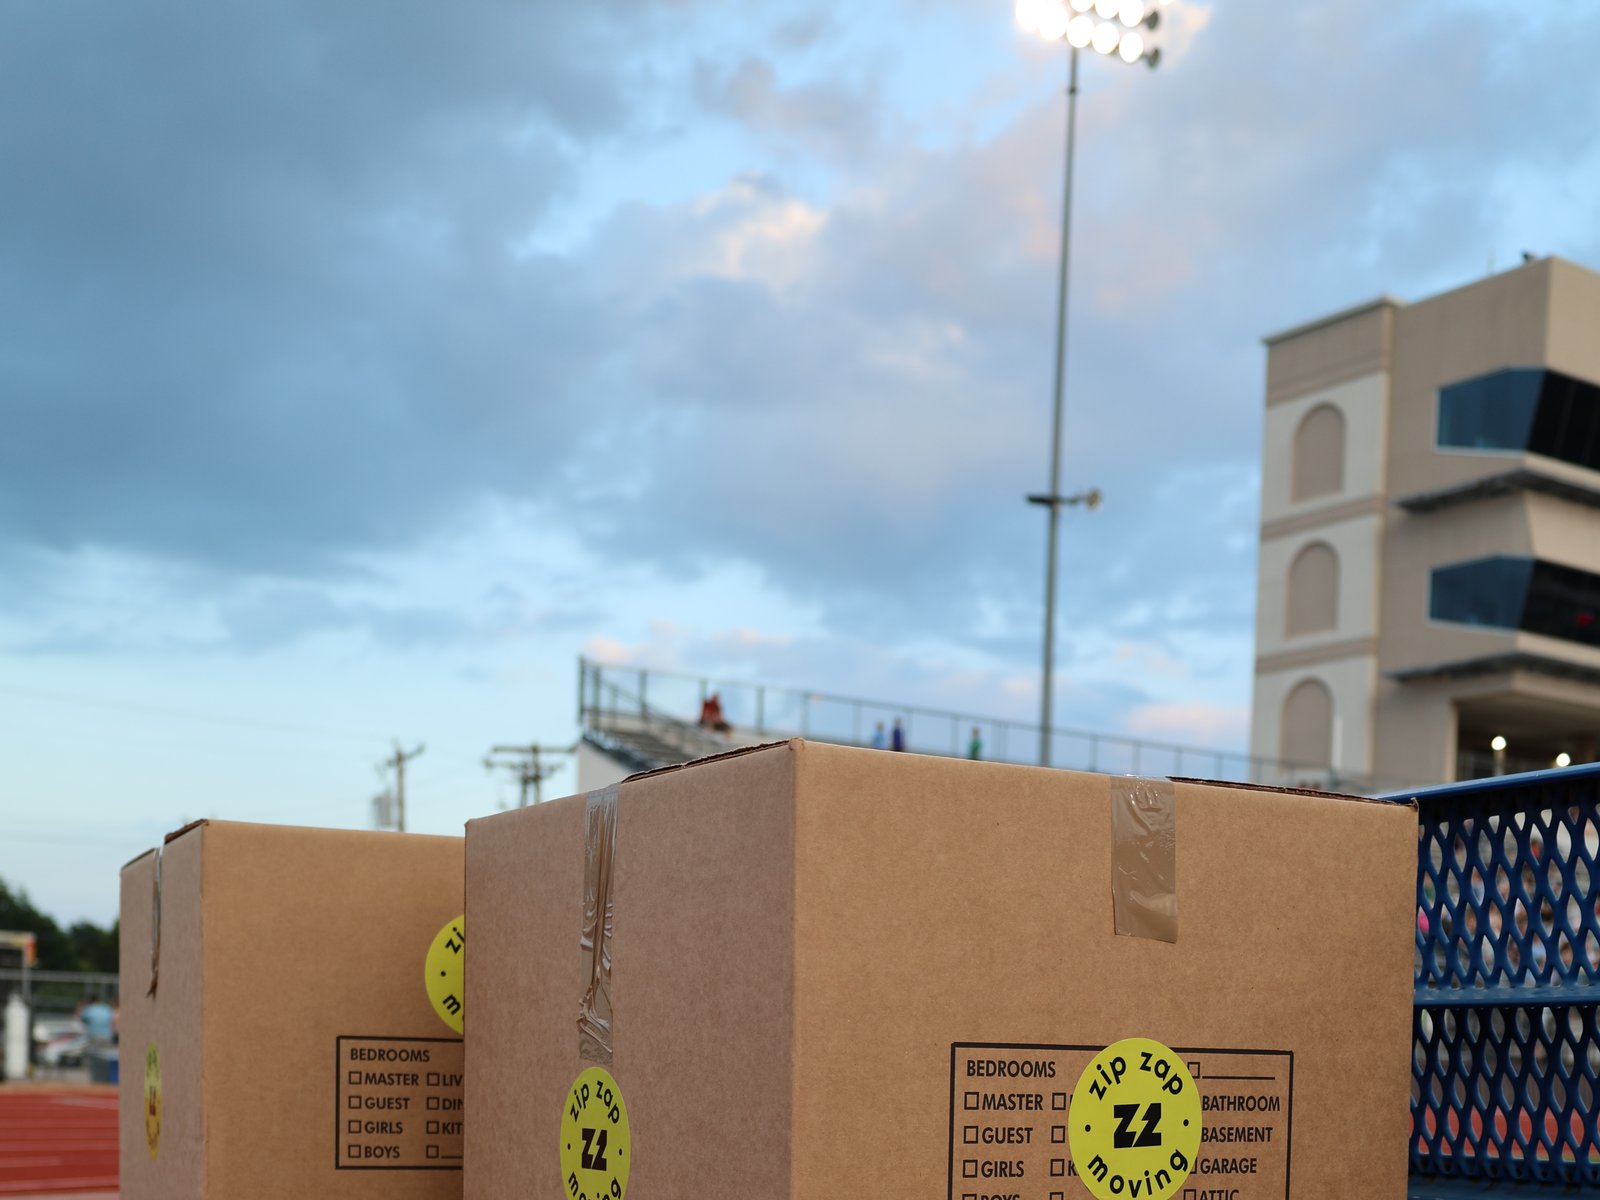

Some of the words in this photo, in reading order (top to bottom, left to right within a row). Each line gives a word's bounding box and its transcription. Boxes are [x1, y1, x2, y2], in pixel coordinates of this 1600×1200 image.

[350, 1048, 430, 1063] BEDROOMS
[966, 1059, 1056, 1078] BEDROOMS
[1089, 1055, 1127, 1101] zip
[1139, 1052, 1183, 1095] zap
[364, 1072, 420, 1087] MASTER
[364, 1097, 411, 1111] GUEST
[570, 1083, 590, 1122] zip
[596, 1080, 620, 1124] zap
[982, 1093, 1044, 1111] MASTER
[1202, 1095, 1280, 1112] BATHROOM
[364, 1121, 404, 1135] GIRLS
[981, 1127, 1033, 1144] GUEST
[1201, 1127, 1273, 1143] BASEMENT
[364, 1145, 401, 1159] BOYS
[981, 1160, 1025, 1178] GIRLS
[1087, 1149, 1189, 1199] moving
[1200, 1158, 1257, 1174] GARAGE
